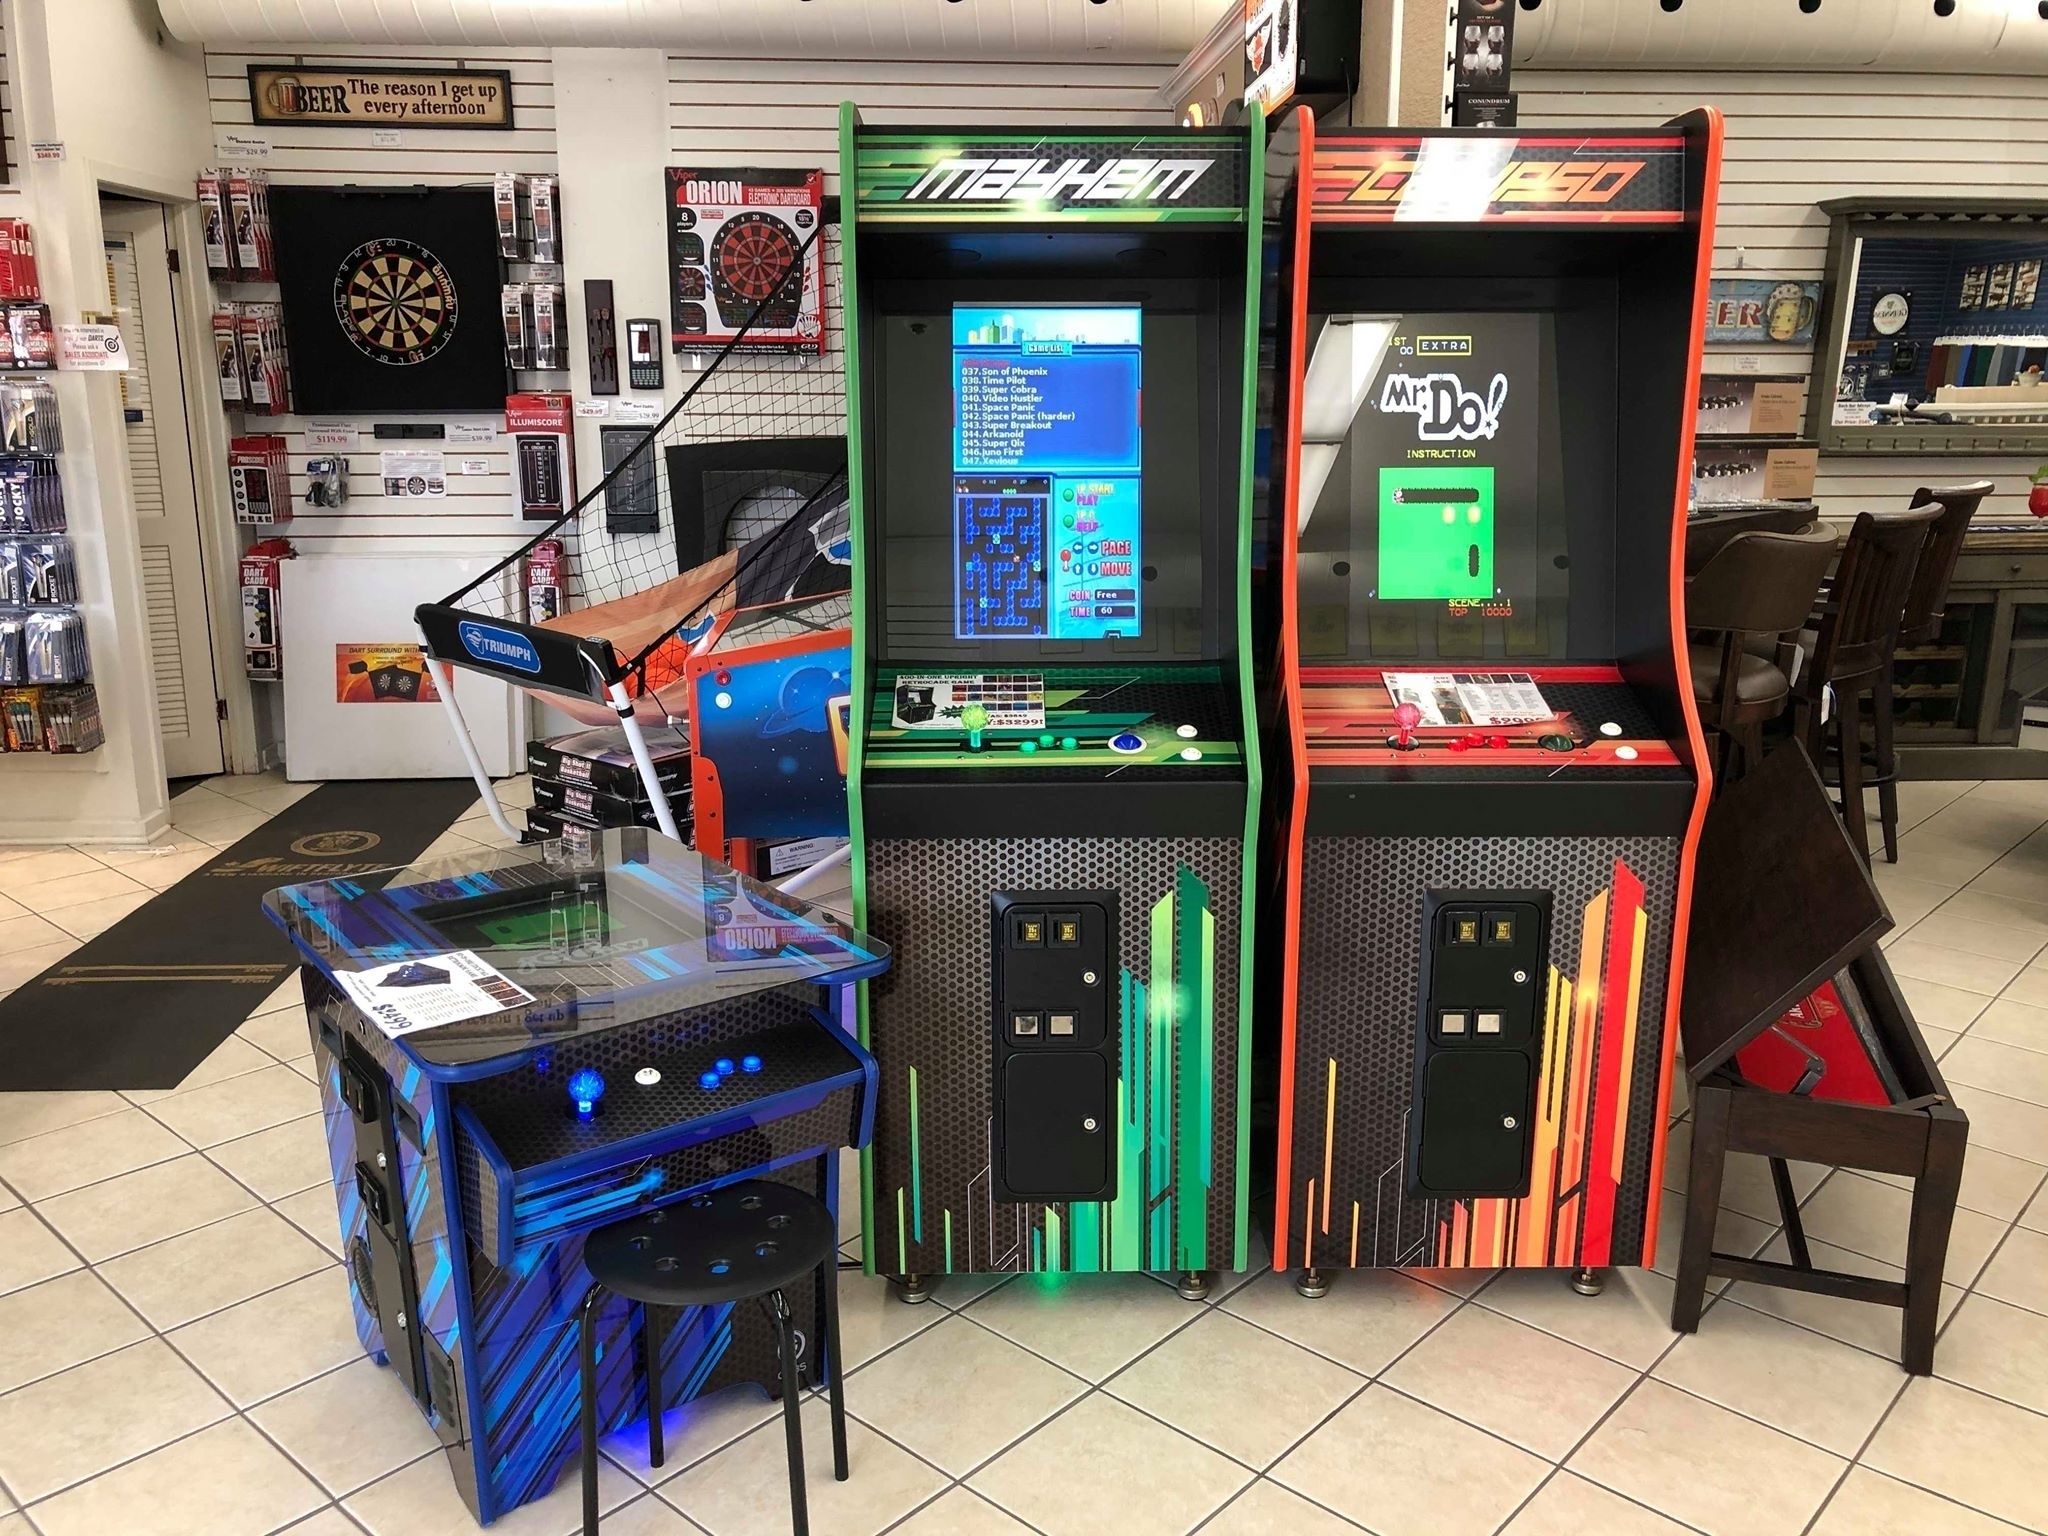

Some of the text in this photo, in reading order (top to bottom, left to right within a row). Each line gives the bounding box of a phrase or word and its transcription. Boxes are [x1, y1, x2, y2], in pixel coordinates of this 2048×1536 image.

[347, 78, 497, 103] The reason I get up
[298, 84, 351, 114] BEER
[364, 98, 486, 118] every afternoon
[667, 168, 698, 183] Viper
[686, 181, 743, 204] ORION
[749, 193, 811, 205] ELECTRONIC DARTBOARD
[681, 212, 688, 221] 8
[1421, 341, 1468, 350] EXTRA
[1002, 367, 1010, 376] of
[1012, 367, 1049, 376] Phoenix
[1006, 376, 1027, 385] Pilot
[1010, 385, 1037, 394] Cobra
[1010, 394, 1044, 403] Hustler
[1011, 403, 1036, 412] Panic
[1380, 373, 1508, 440] Mr. Do!
[1011, 412, 1036, 420] Panic
[1037, 411, 1075, 421] (harder)
[510, 418, 563, 426] ILLUMISCORE
[1010, 421, 1052, 430] Breakout
[316, 435, 348, 443] $119.99
[1010, 439, 1025, 448] Qix
[1004, 448, 1024, 456] First
[1406, 449, 1476, 459] INSTRUCTION
[11, 482, 26, 522] JOCKY
[1077, 494, 1098, 506] PLAY
[1101, 540, 1132, 556] PAGE
[243, 568, 265, 577] DART
[530, 568, 551, 577] DART
[1100, 561, 1132, 577] MOVE
[245, 577, 269, 585] CADDY
[531, 576, 556, 584] CADDY
[1069, 590, 1118, 602] COIN Free
[1069, 606, 1113, 618] TIME 60
[1448, 608, 1512, 616] TOP 10000
[484, 638, 531, 662] TRIUMPH
[562, 755, 571, 767] Big
[572, 757, 585, 770] Shot
[560, 763, 591, 781] Basketball
[565, 786, 574, 799] Big
[575, 789, 587, 801] Shot
[564, 796, 593, 813] Basketball
[789, 842, 814, 853] WARNING
